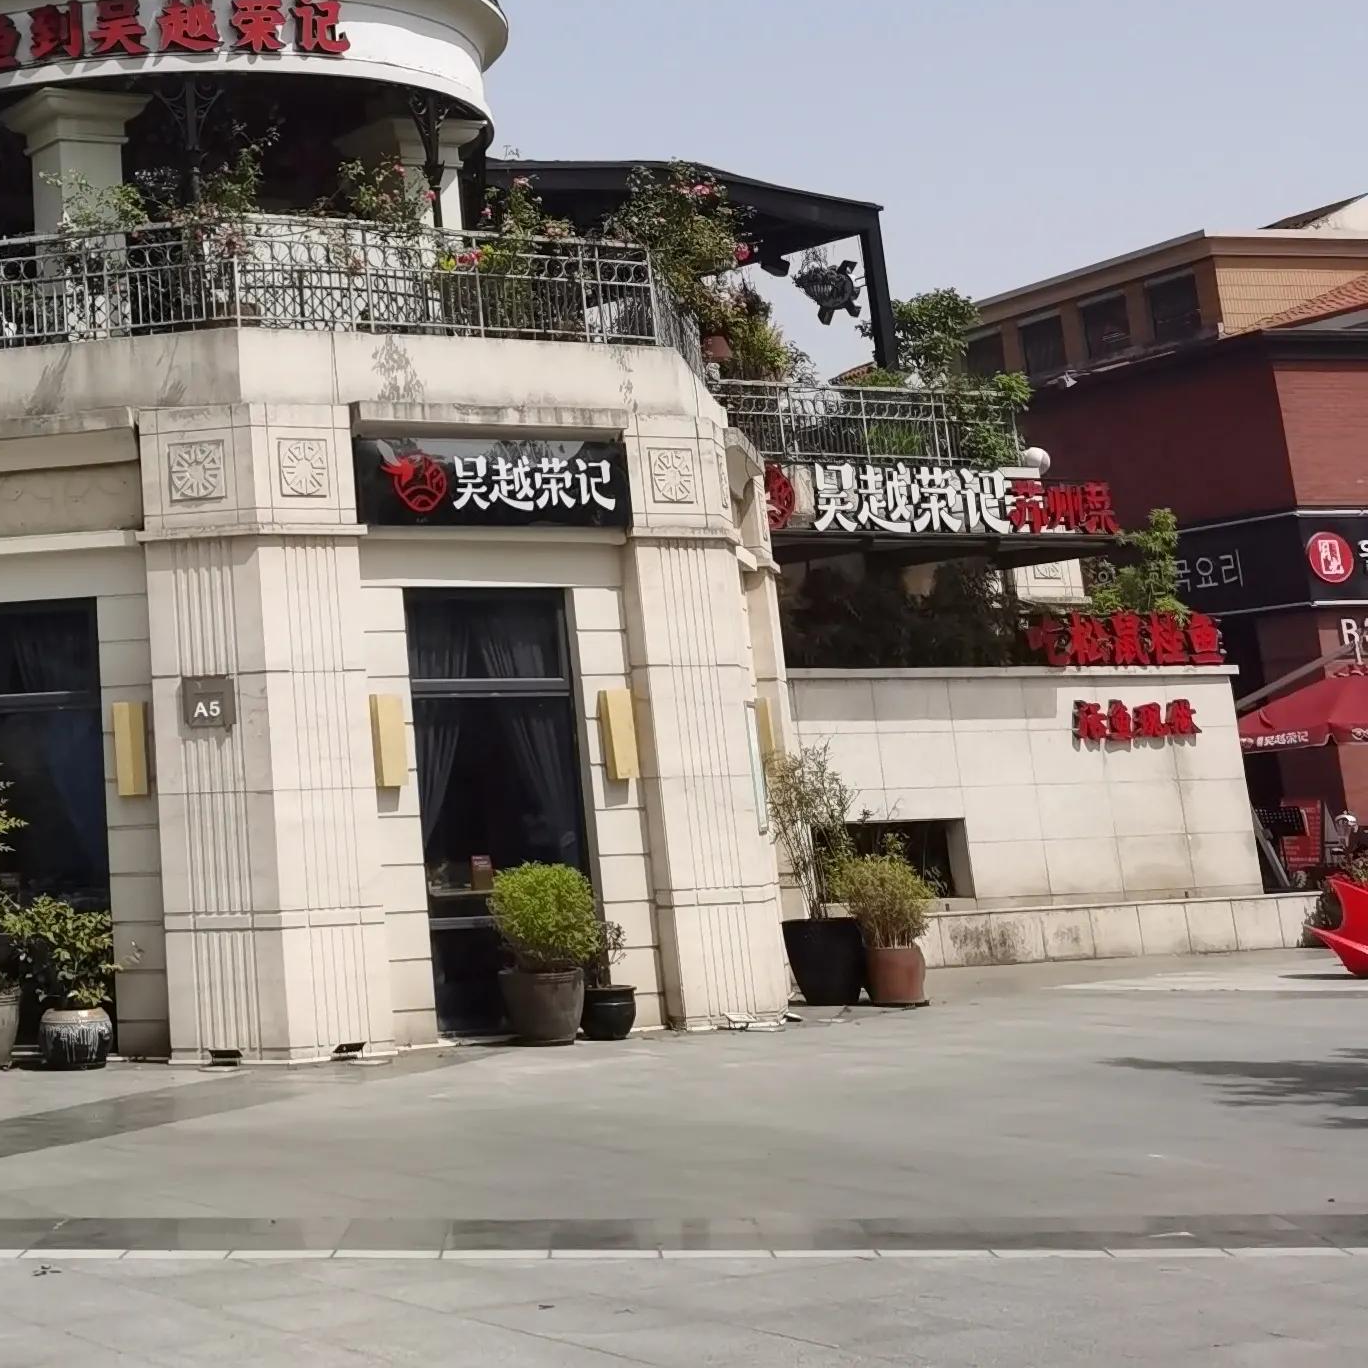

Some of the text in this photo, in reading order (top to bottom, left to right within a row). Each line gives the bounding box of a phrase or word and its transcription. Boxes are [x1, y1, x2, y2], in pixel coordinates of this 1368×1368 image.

[453, 455, 616, 511] 吴越荣记
[814, 462, 1121, 536] 吴越荣记 苏州菜
[1026, 608, 1225, 665] 吃松鼠桂鱼
[193, 701, 221, 718] A5
[1263, 731, 1309, 747] 吴越荣记
